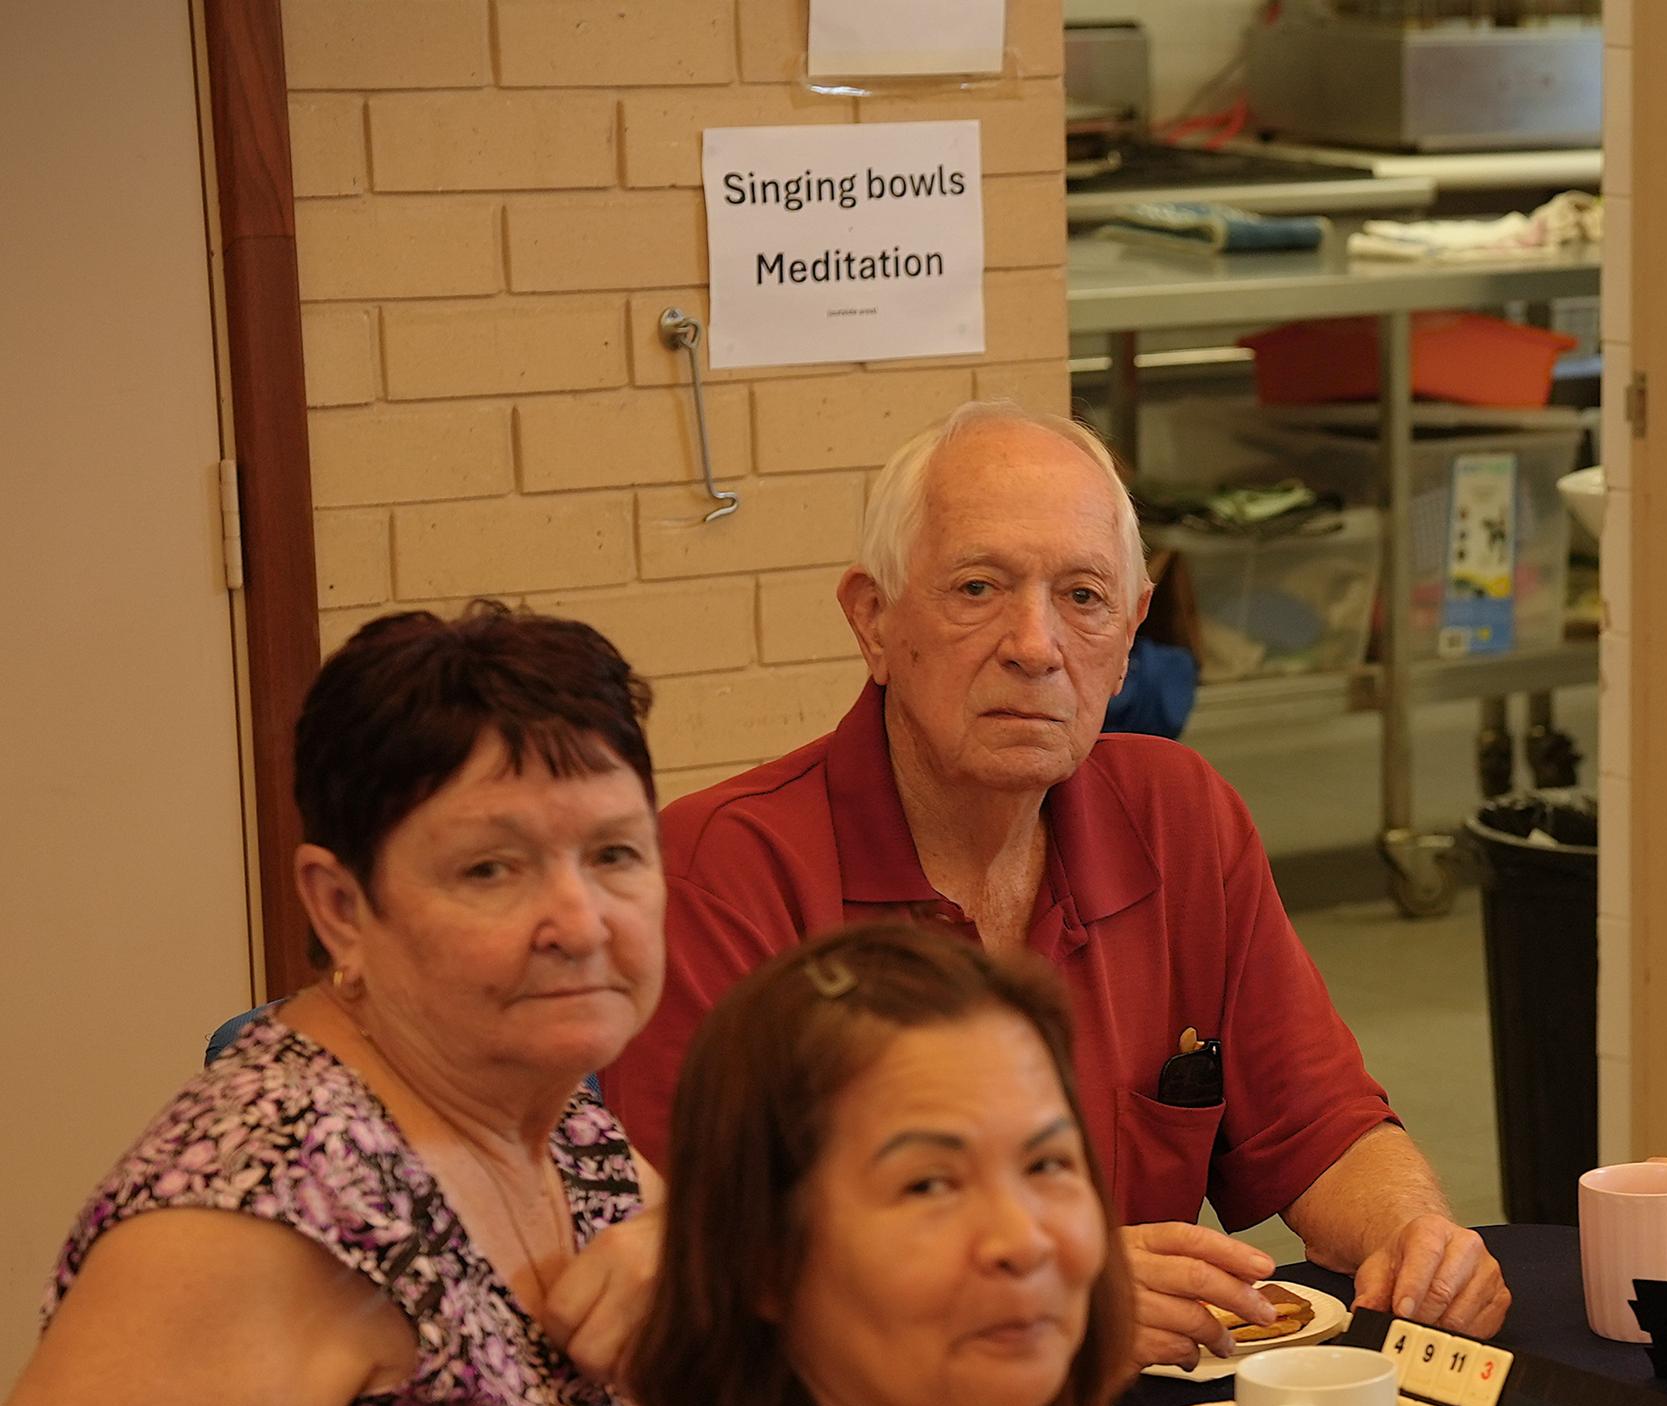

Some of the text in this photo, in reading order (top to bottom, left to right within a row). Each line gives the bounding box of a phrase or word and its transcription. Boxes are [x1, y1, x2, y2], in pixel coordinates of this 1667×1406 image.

[722, 163, 966, 211] Singing bowls
[756, 246, 944, 286] Meditation
[1394, 1335, 1495, 1381] 4 9 11 3
